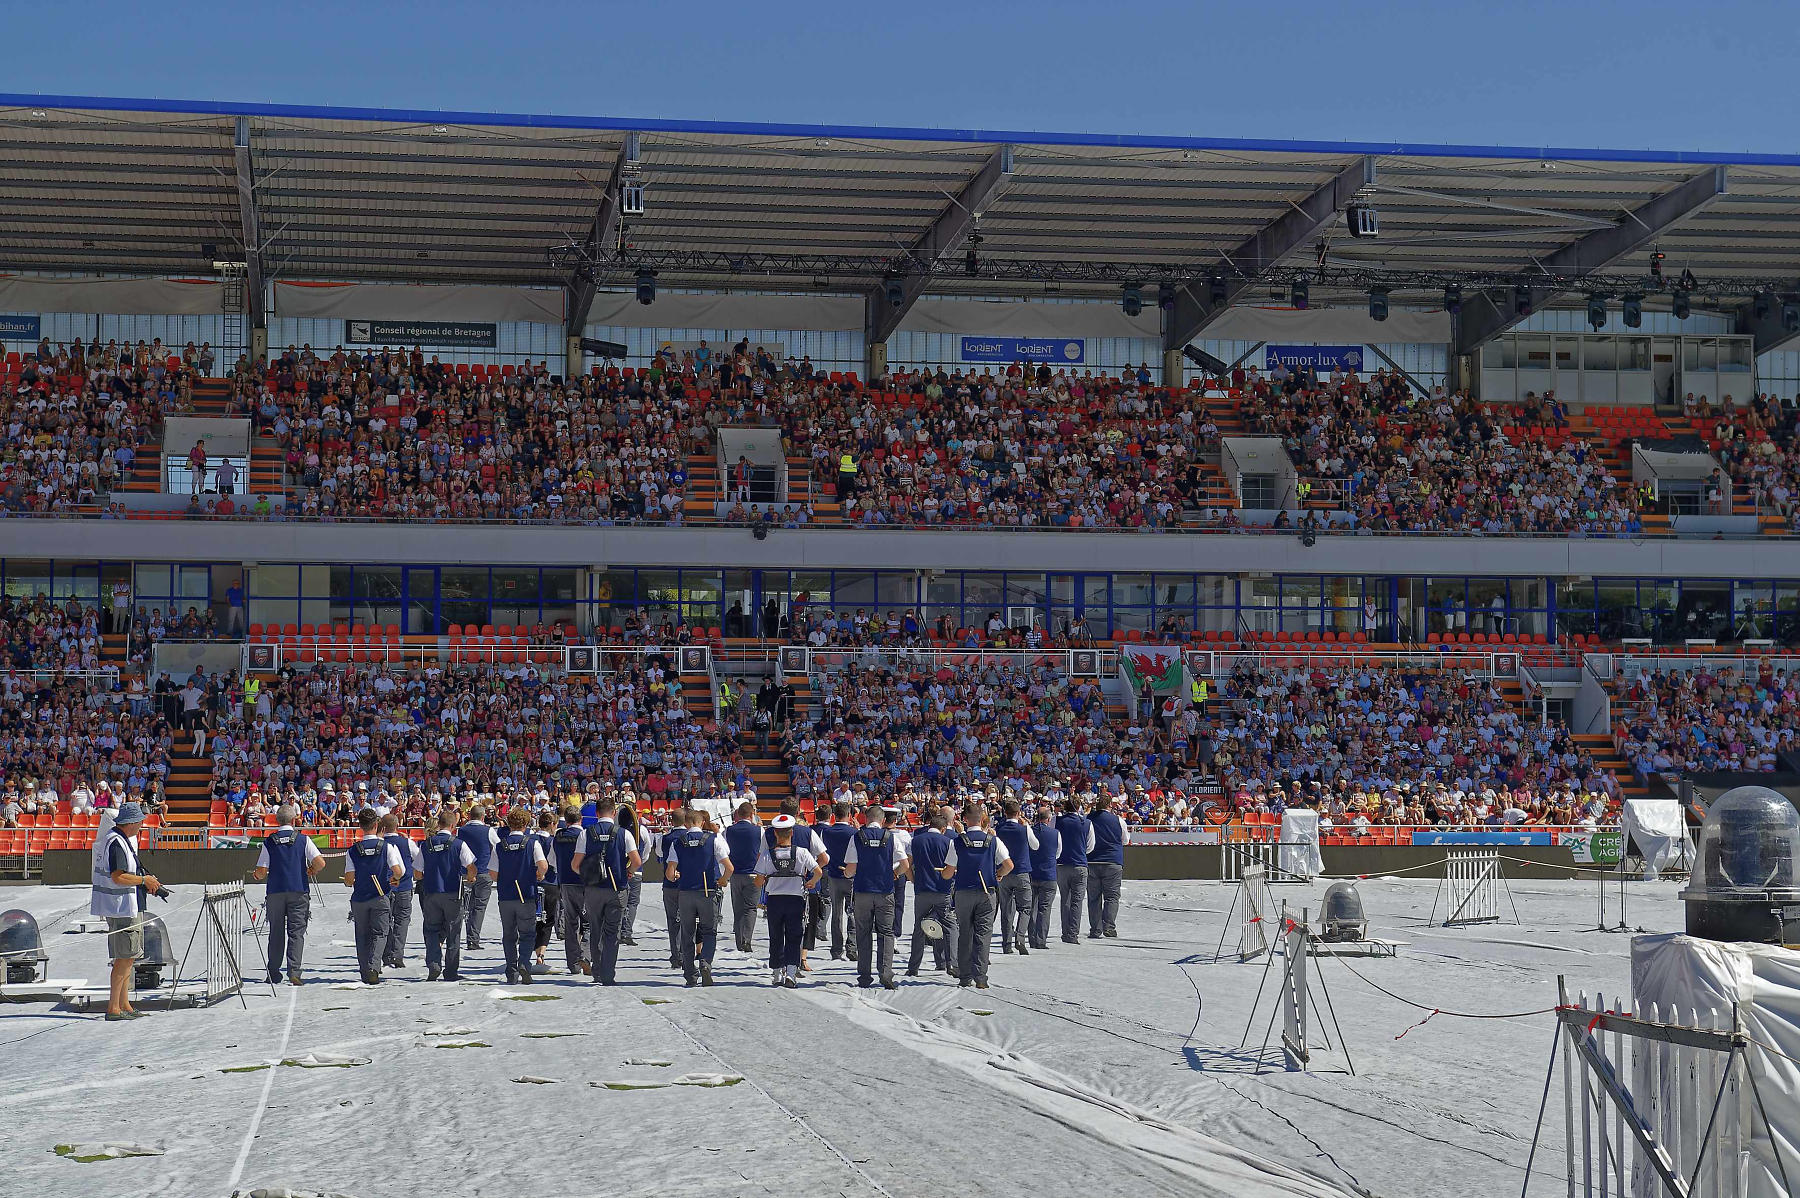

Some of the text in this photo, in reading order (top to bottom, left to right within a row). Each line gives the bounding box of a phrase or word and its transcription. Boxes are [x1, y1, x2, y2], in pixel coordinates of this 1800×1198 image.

[374, 326, 491, 338] Conseil régional de Bretagne
[1194, 786, 1222, 794] LORIENT
